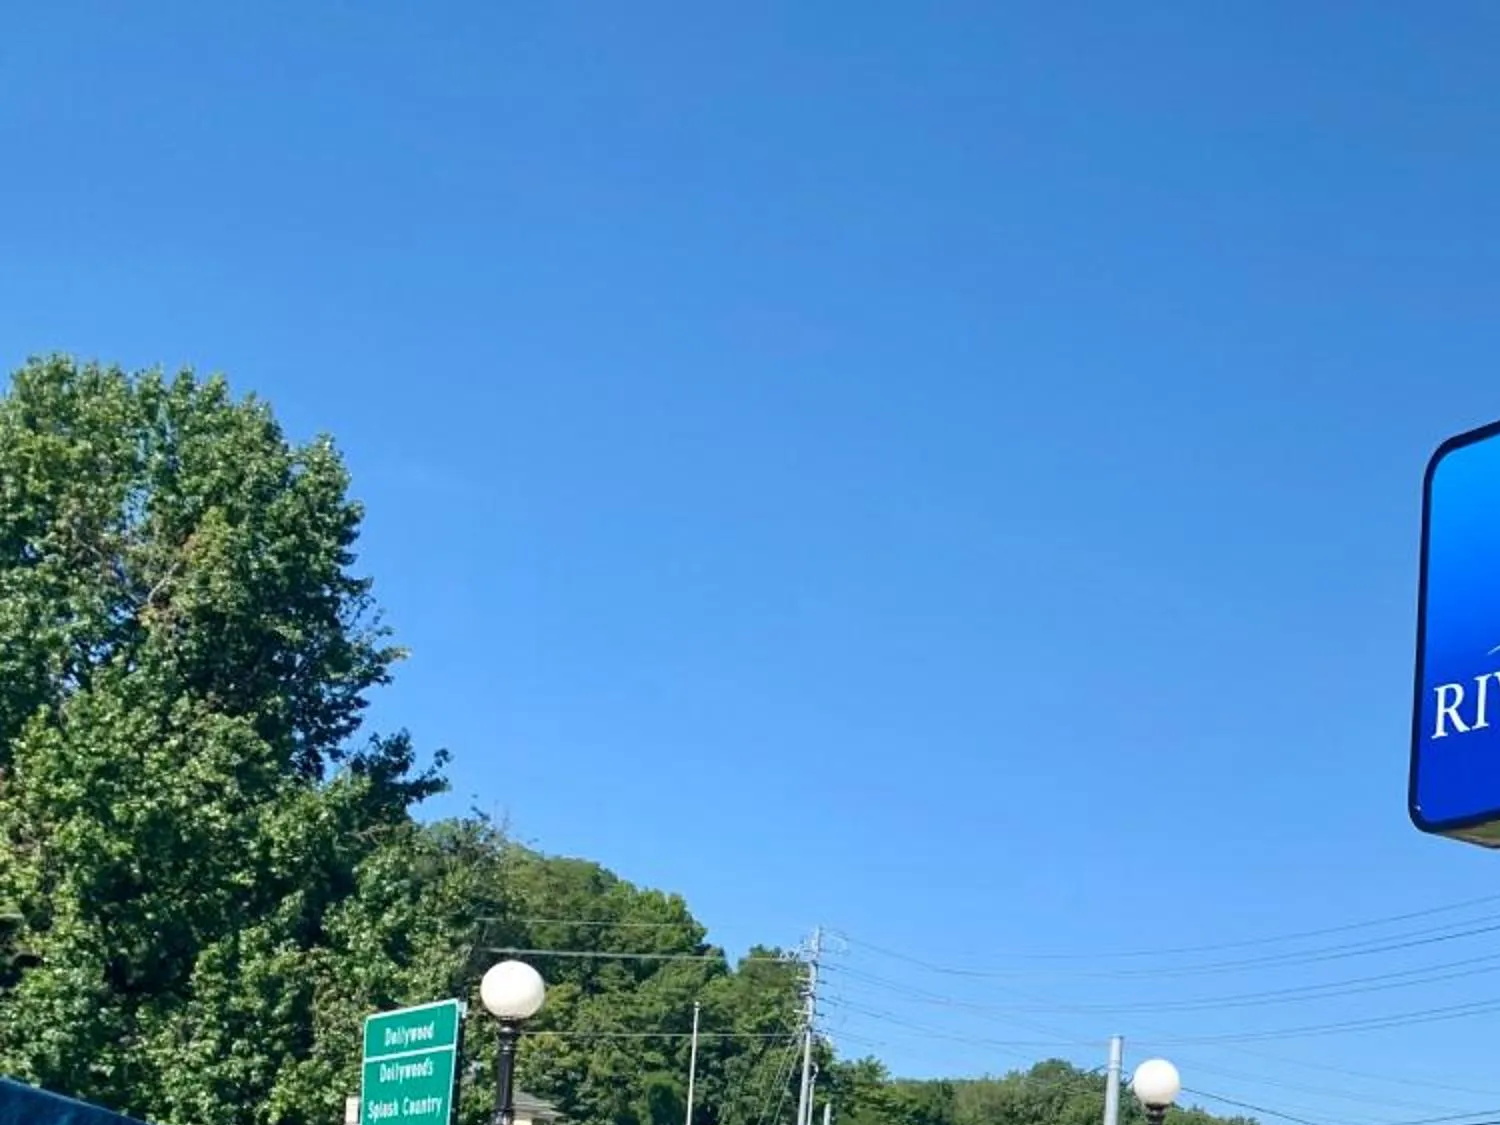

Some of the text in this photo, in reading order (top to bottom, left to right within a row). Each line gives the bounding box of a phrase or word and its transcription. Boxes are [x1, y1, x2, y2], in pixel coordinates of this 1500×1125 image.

[384, 1021, 435, 1048] Dollywood
[367, 1095, 443, 1124] Splash Country
